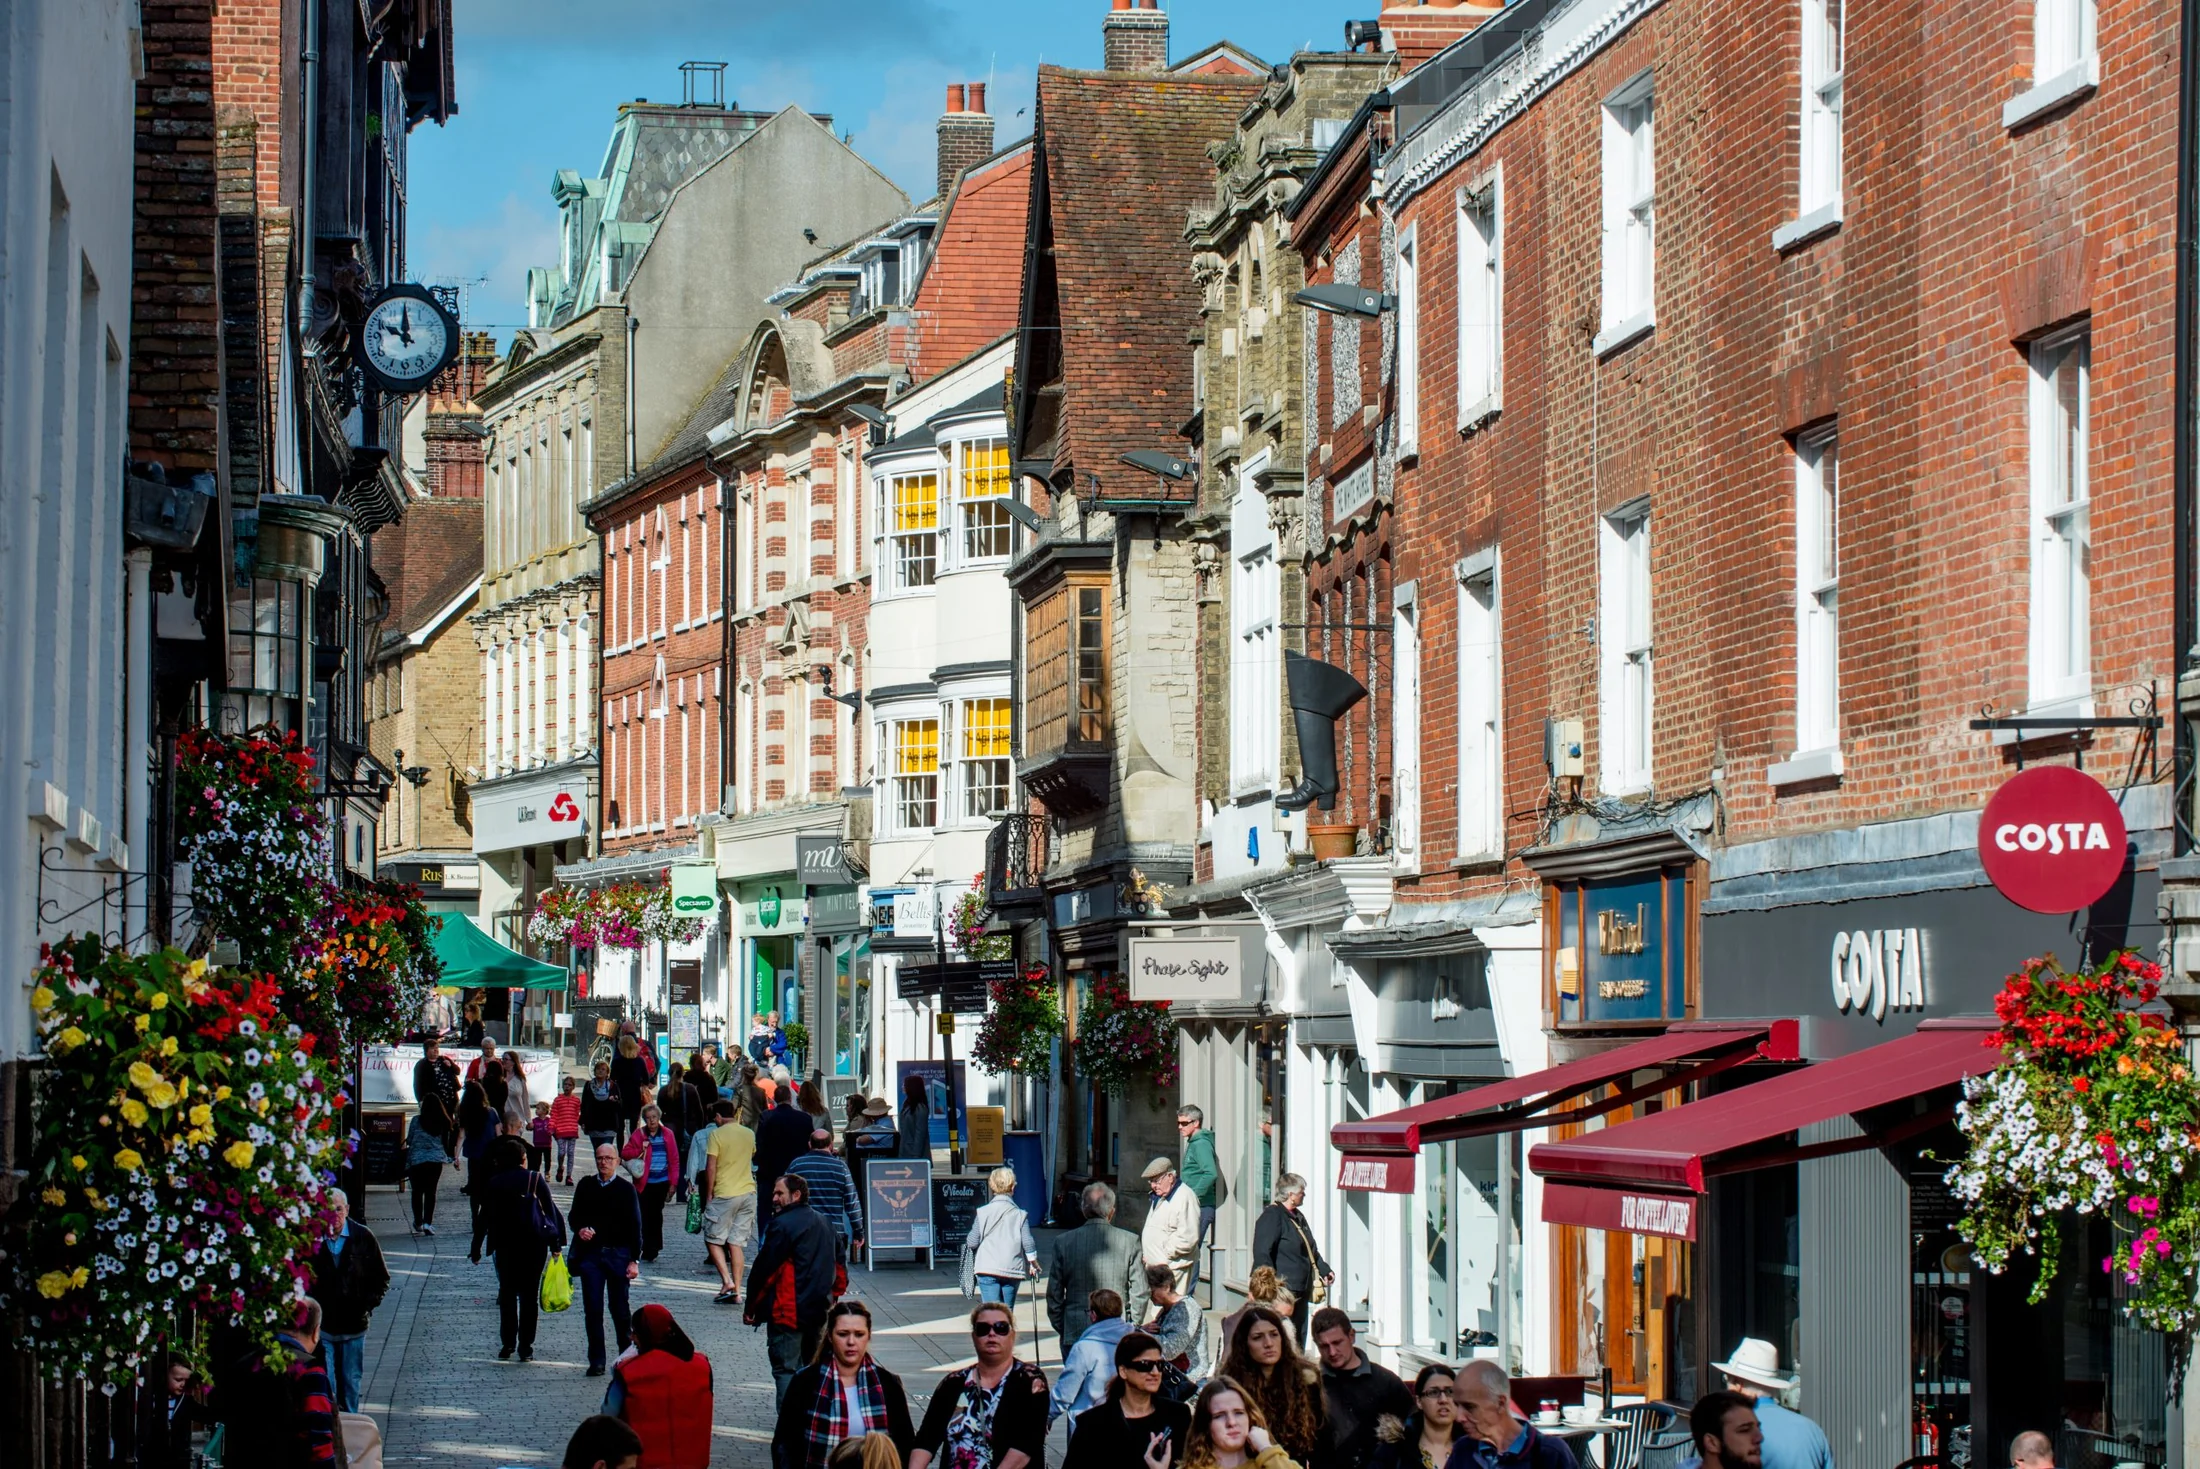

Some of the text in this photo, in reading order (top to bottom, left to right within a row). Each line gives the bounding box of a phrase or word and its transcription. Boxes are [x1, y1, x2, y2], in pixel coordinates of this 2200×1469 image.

[401, 358, 410, 370] 6
[415, 355, 425, 368] 5
[1995, 823, 2111, 855] COSTA
[678, 899, 711, 907] Specsavers
[826, 895, 842, 912] MINT
[899, 901, 932, 920] Bellis
[1142, 957, 1187, 978] Phase
[1831, 928, 1924, 1021] COSTA
[364, 1056, 412, 1076] Luxury
[1339, 1161, 1354, 1187] FOR
[942, 1184, 974, 1197] Nicola's
[1621, 1196, 1690, 1236] FOR COFFEE LOVERS
